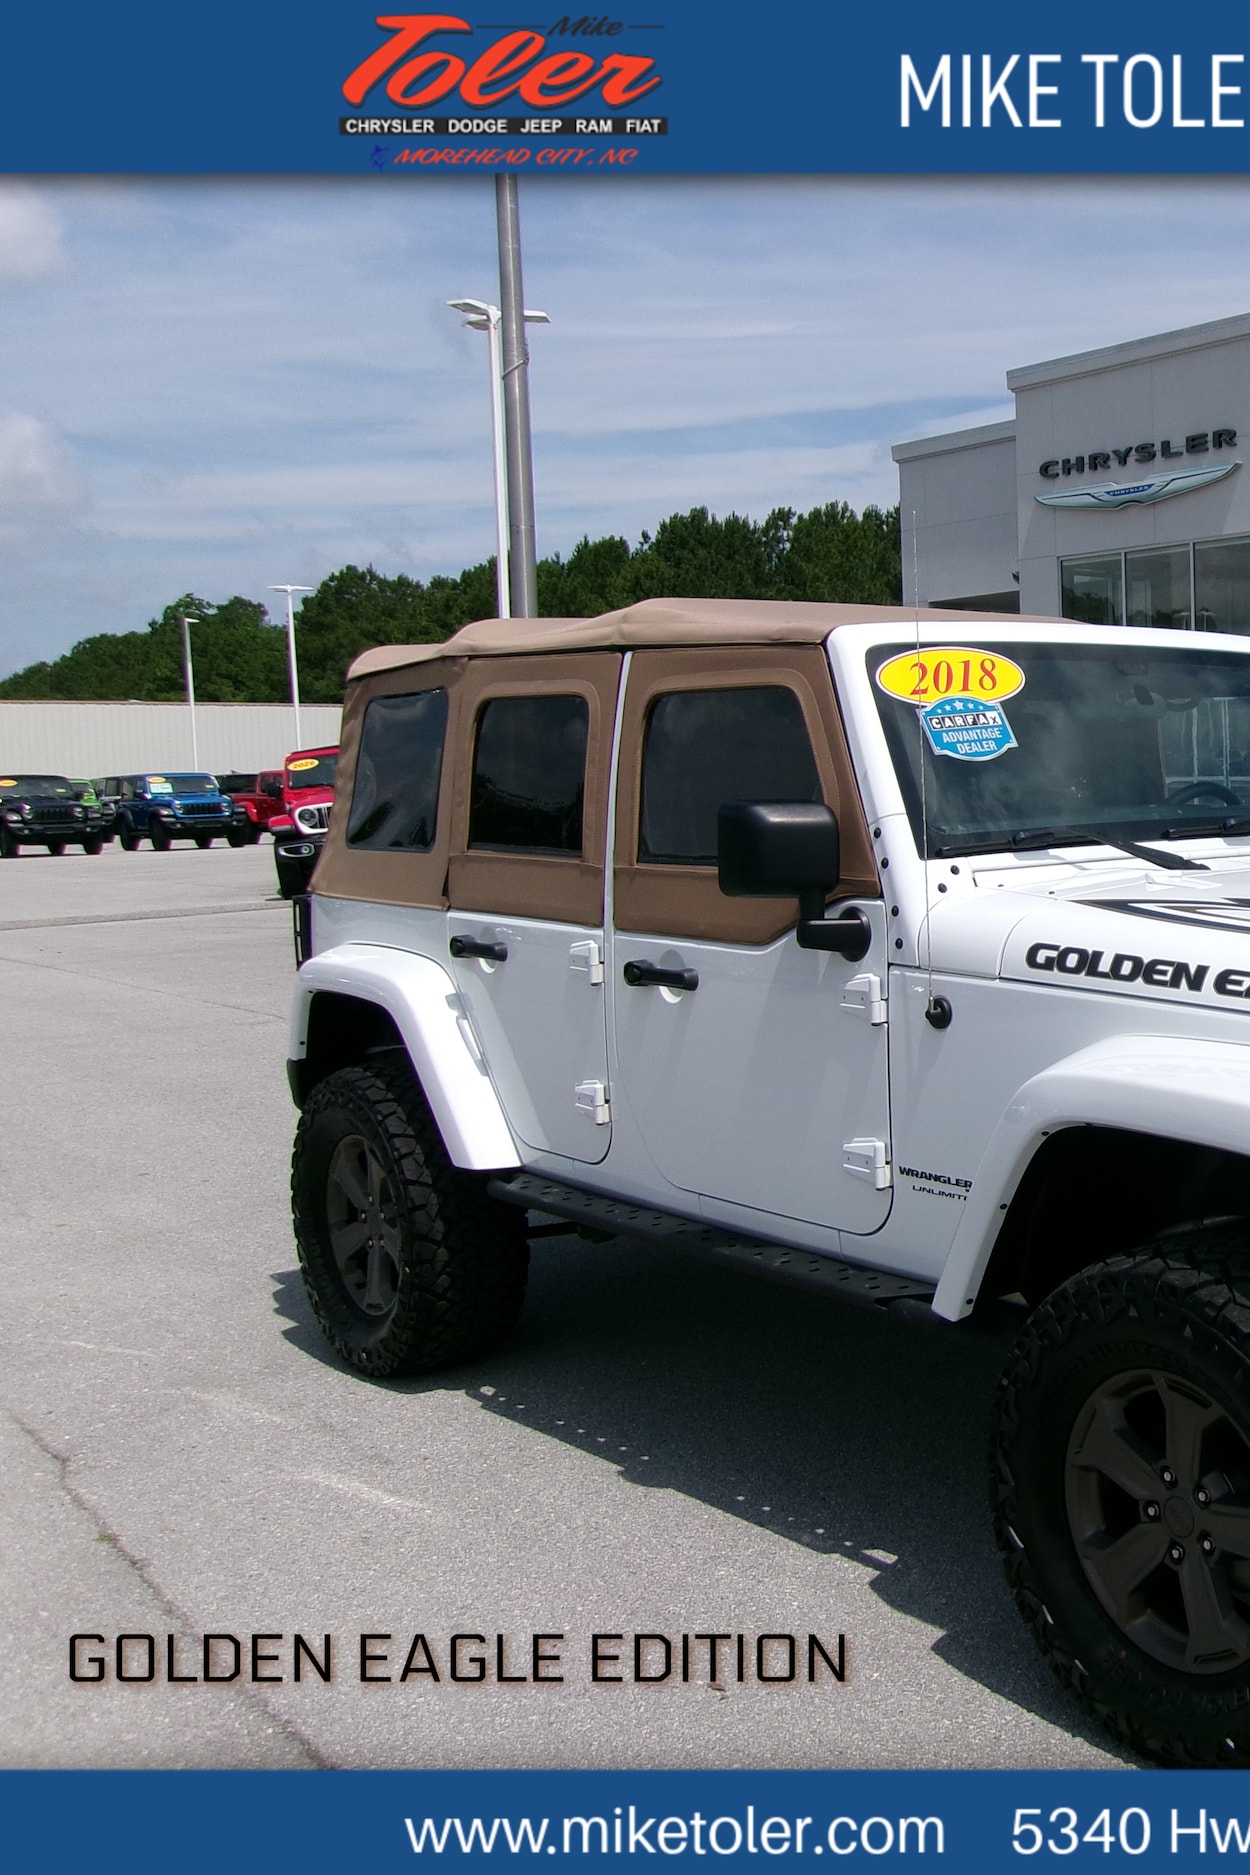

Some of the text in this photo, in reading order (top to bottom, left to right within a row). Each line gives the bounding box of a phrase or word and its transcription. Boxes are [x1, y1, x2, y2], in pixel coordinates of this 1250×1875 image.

[1038, 427, 1238, 479] CHRYSLER
[909, 657, 998, 696] 2018
[930, 711, 1001, 730] CARFAX
[942, 727, 1003, 744] ADVANTAGE
[956, 740, 998, 755] DEALER
[1026, 941, 1210, 992] GOLDEN
[898, 1165, 973, 1189] WRANGLER
